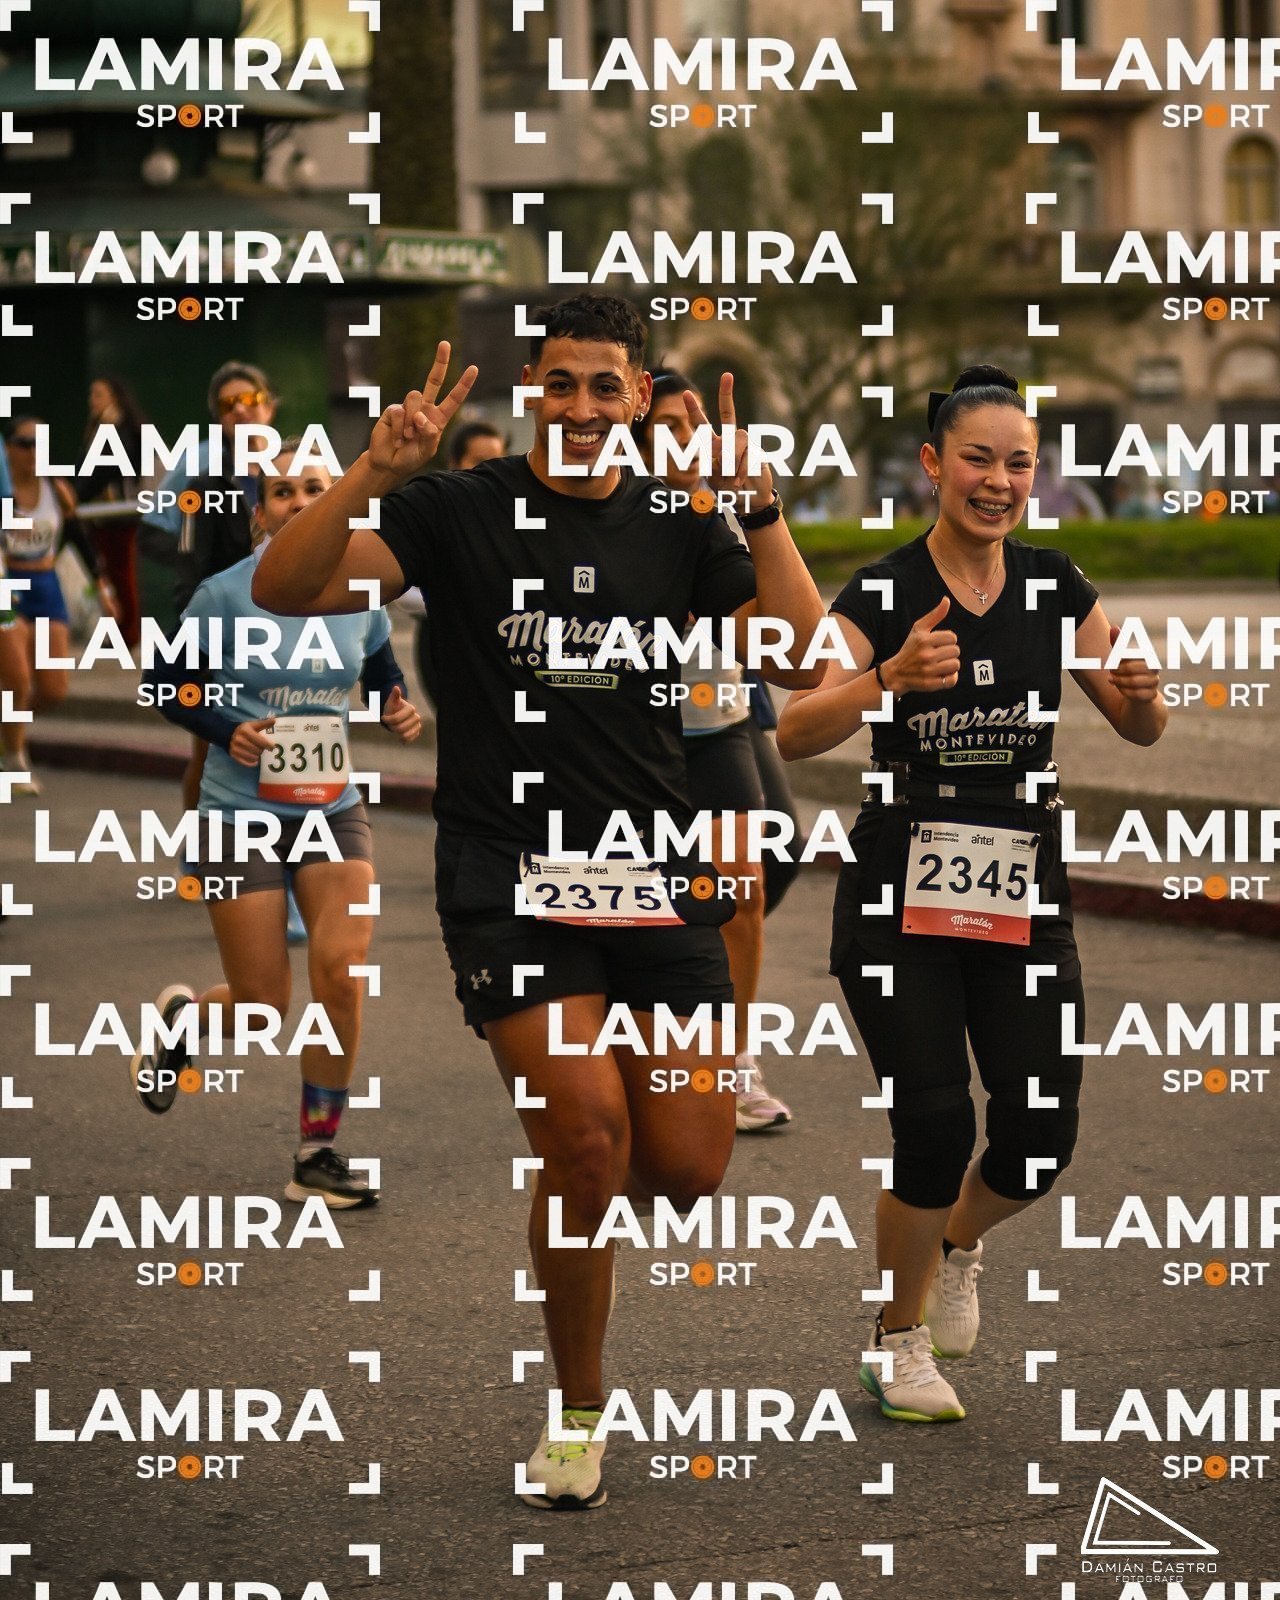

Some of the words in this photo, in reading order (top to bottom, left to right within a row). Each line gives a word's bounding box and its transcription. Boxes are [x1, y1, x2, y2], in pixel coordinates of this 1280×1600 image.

[920, 733, 1037, 752] MONTEVIDEO
[267, 742, 344, 773] 3310
[971, 834, 994, 846] antel
[583, 865, 609, 875] antel
[916, 854, 1028, 901] 2345
[534, 883, 662, 911] 2375
[951, 915, 993, 930] Maratón
